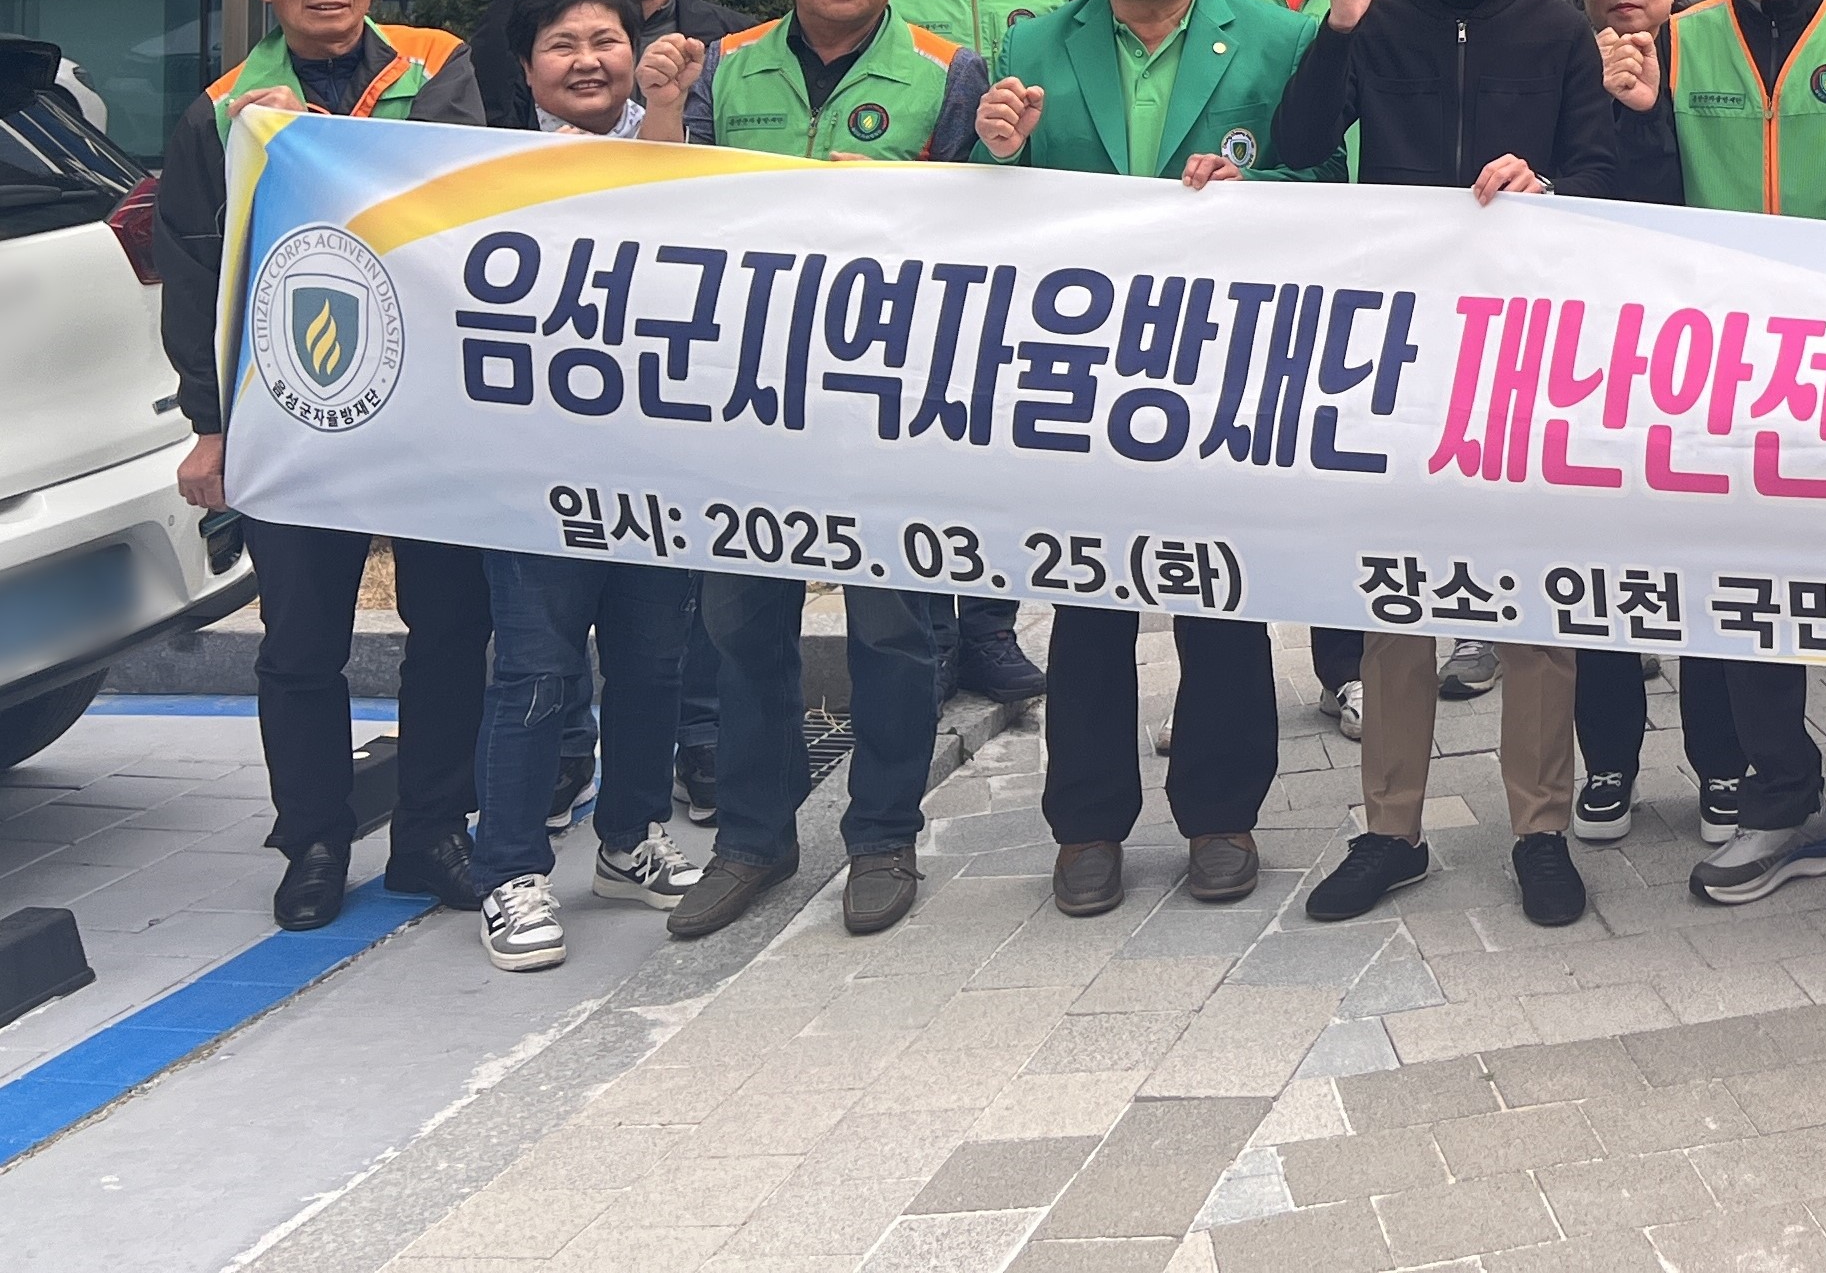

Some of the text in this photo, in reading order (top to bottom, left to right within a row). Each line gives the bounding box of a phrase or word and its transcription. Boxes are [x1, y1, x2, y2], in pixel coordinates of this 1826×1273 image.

[257, 233, 399, 369] CITIZEN CORPS ACTIVE IN DISASTER
[456, 231, 1418, 473] 음성군지역자율방재단
[548, 486, 1243, 612] 일시: 2025. 03. 25.(화)
[1359, 558, 1518, 626] 장소:
[1545, 565, 1682, 640] 인천
